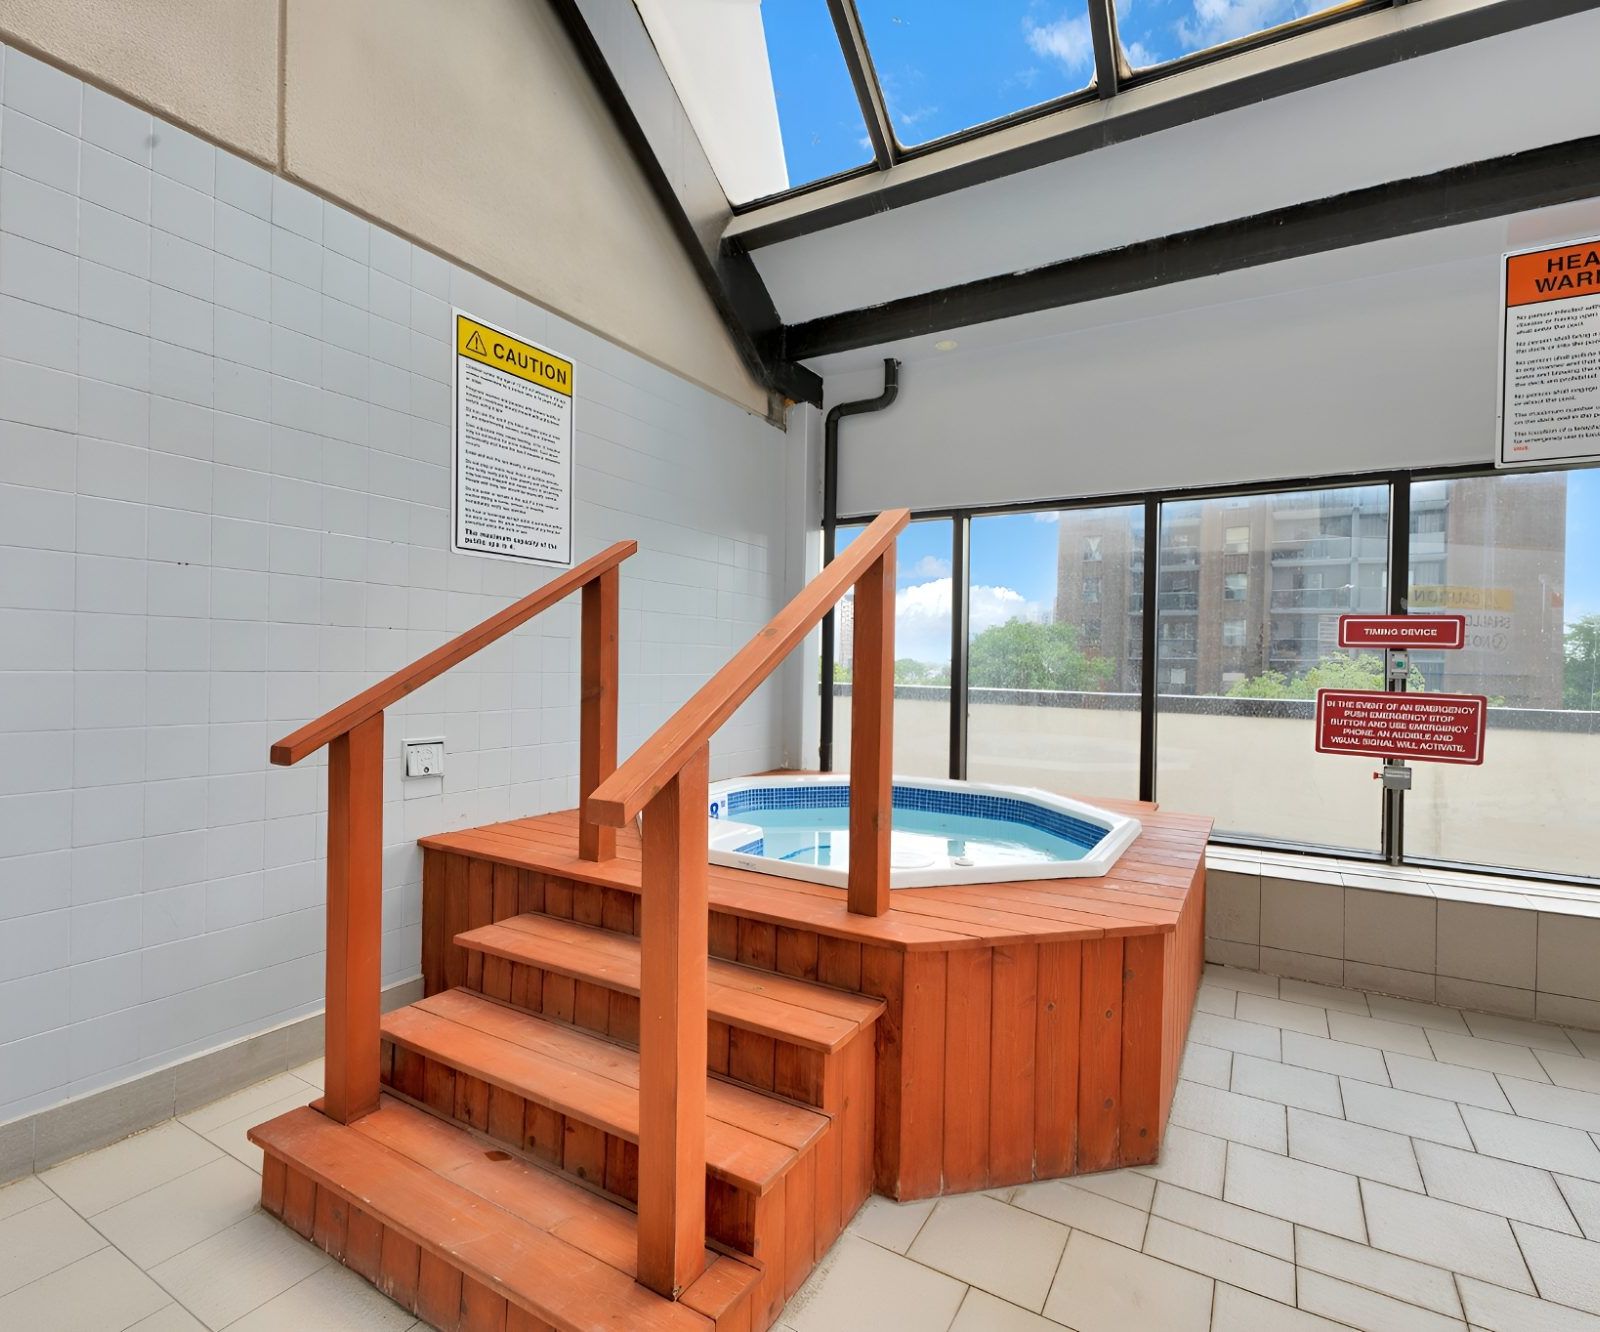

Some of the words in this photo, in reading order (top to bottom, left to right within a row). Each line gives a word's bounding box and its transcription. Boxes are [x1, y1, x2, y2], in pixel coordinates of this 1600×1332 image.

[1547, 251, 1600, 273] HEA
[1535, 269, 1600, 293] WAR
[493, 343, 566, 385] CAUTION
[1364, 628, 1398, 636] TIMING
[1337, 700, 1355, 708] THE
[1356, 701, 1384, 710] EVENT
[1386, 703, 1398, 711] OF
[1414, 705, 1475, 715] EMERGENCY
[1344, 710, 1368, 718] PUSH
[1369, 711, 1427, 721] EMERGENCY
[1429, 715, 1455, 723] STOP
[1330, 718, 1366, 727] BUTTON
[1408, 723, 1469, 733] EMERGENCY
[1331, 736, 1360, 744] VISUAL
[1362, 738, 1394, 747] SIGNAL
[1396, 741, 1417, 749] WILL
[1392, 731, 1432, 740] AUDIBLE
